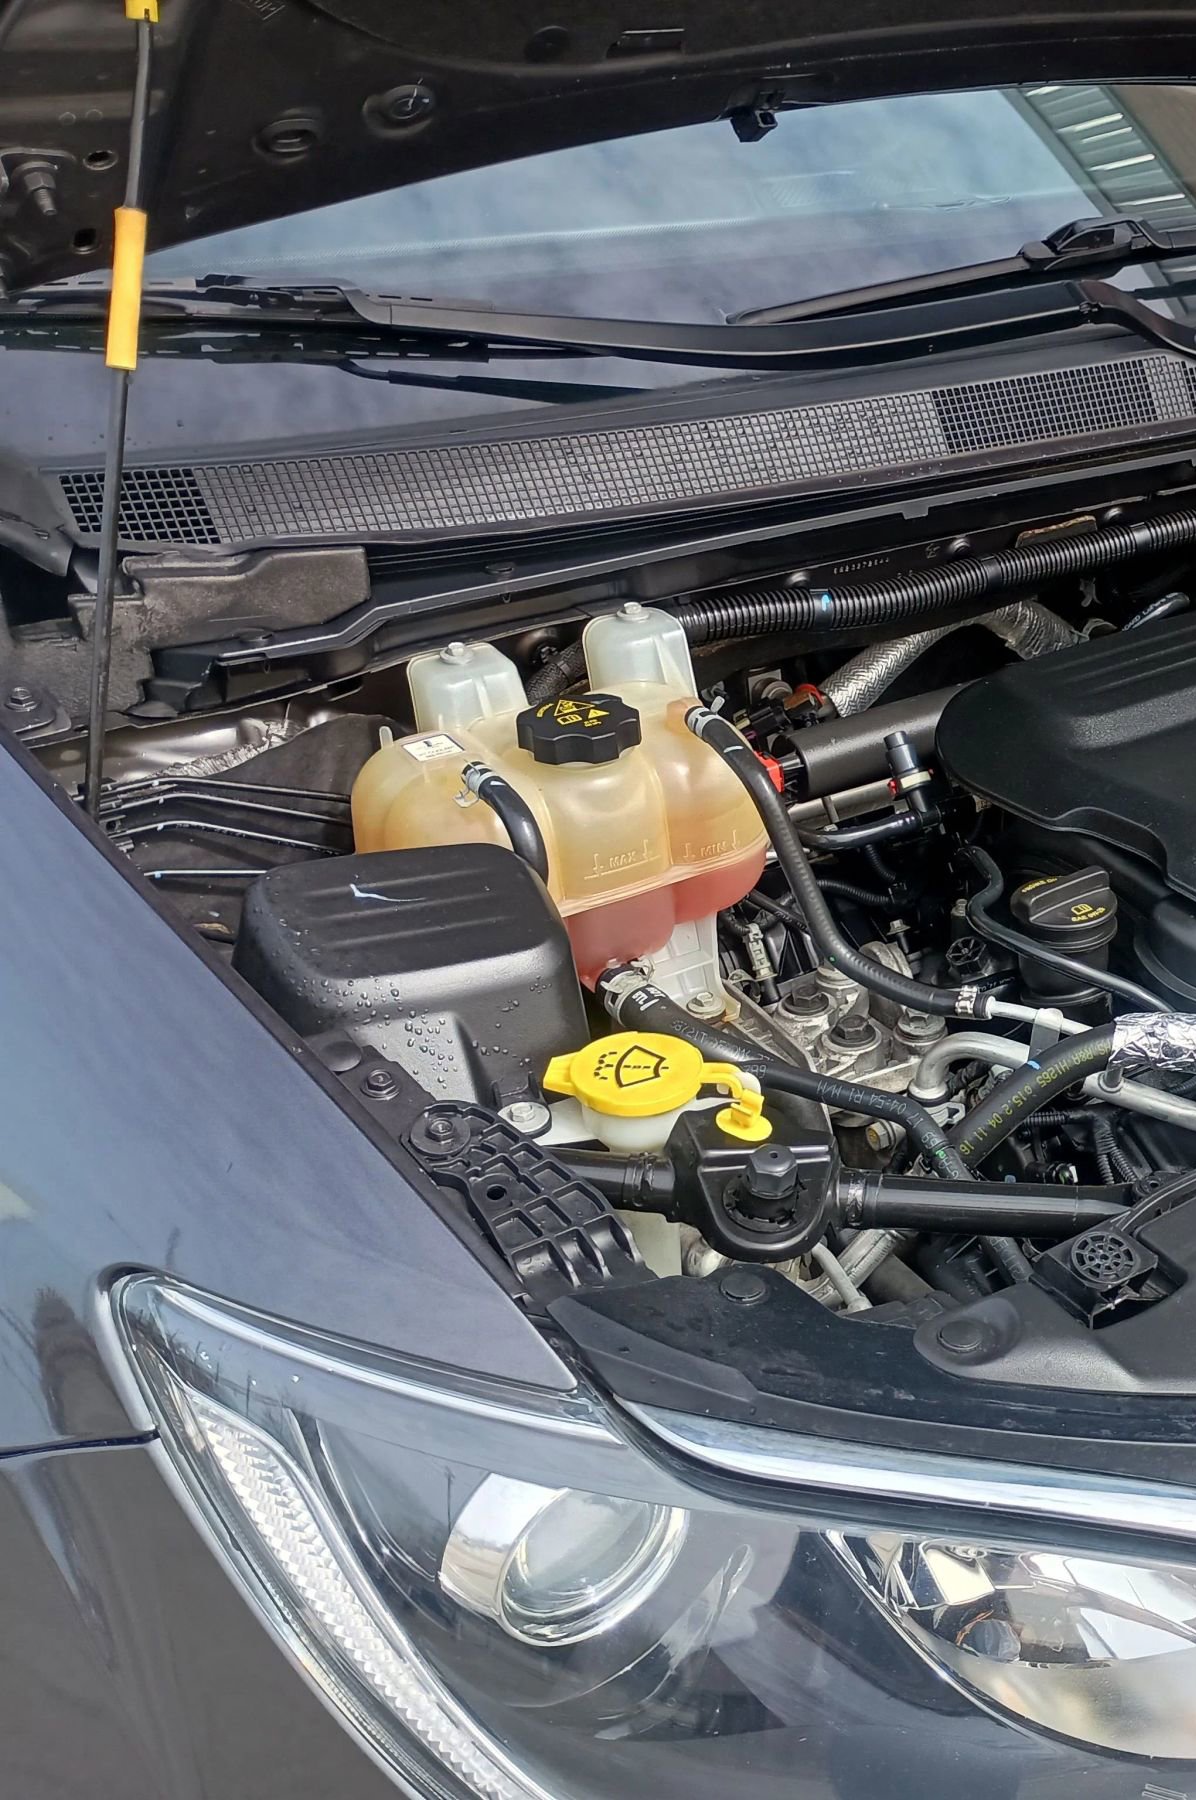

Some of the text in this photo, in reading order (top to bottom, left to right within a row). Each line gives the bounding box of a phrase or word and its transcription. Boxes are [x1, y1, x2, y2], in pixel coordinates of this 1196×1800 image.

[700, 840, 727, 857] MIN
[609, 851, 636, 868] MAX
[959, 1140, 975, 1155] 16
